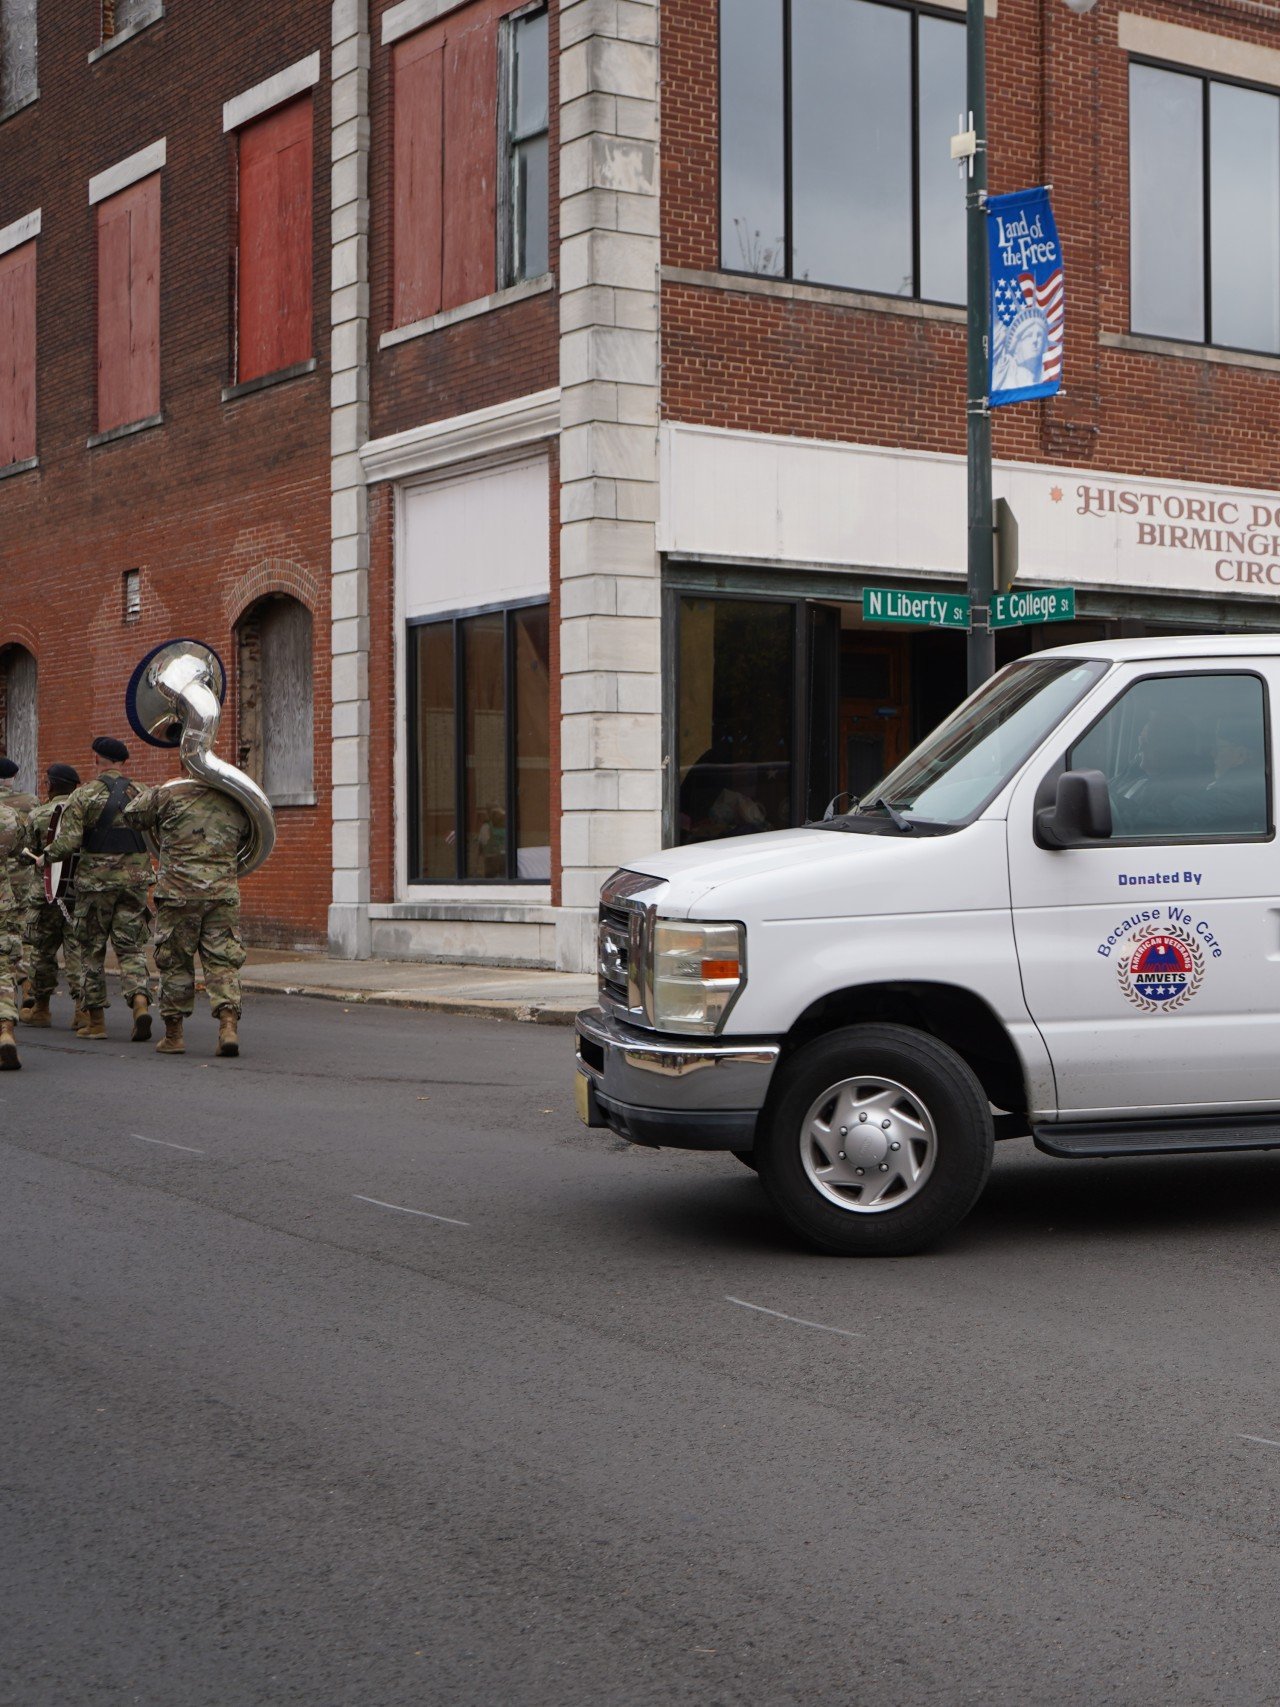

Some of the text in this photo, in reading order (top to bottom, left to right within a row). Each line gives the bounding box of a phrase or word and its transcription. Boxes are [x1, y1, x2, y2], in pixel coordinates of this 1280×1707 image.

[996, 210, 1044, 247] Land of
[1003, 237, 1056, 270] the Free
[1076, 485, 1239, 524] HISTORIC
[870, 592, 963, 623] N Liberty St
[997, 594, 1069, 621] E College St
[1118, 872, 1202, 885] Donated By
[1097, 906, 1223, 958] Because We Care
[1131, 937, 1191, 970] AMERICAN VETERANS
[1136, 973, 1186, 983] AMVETS
